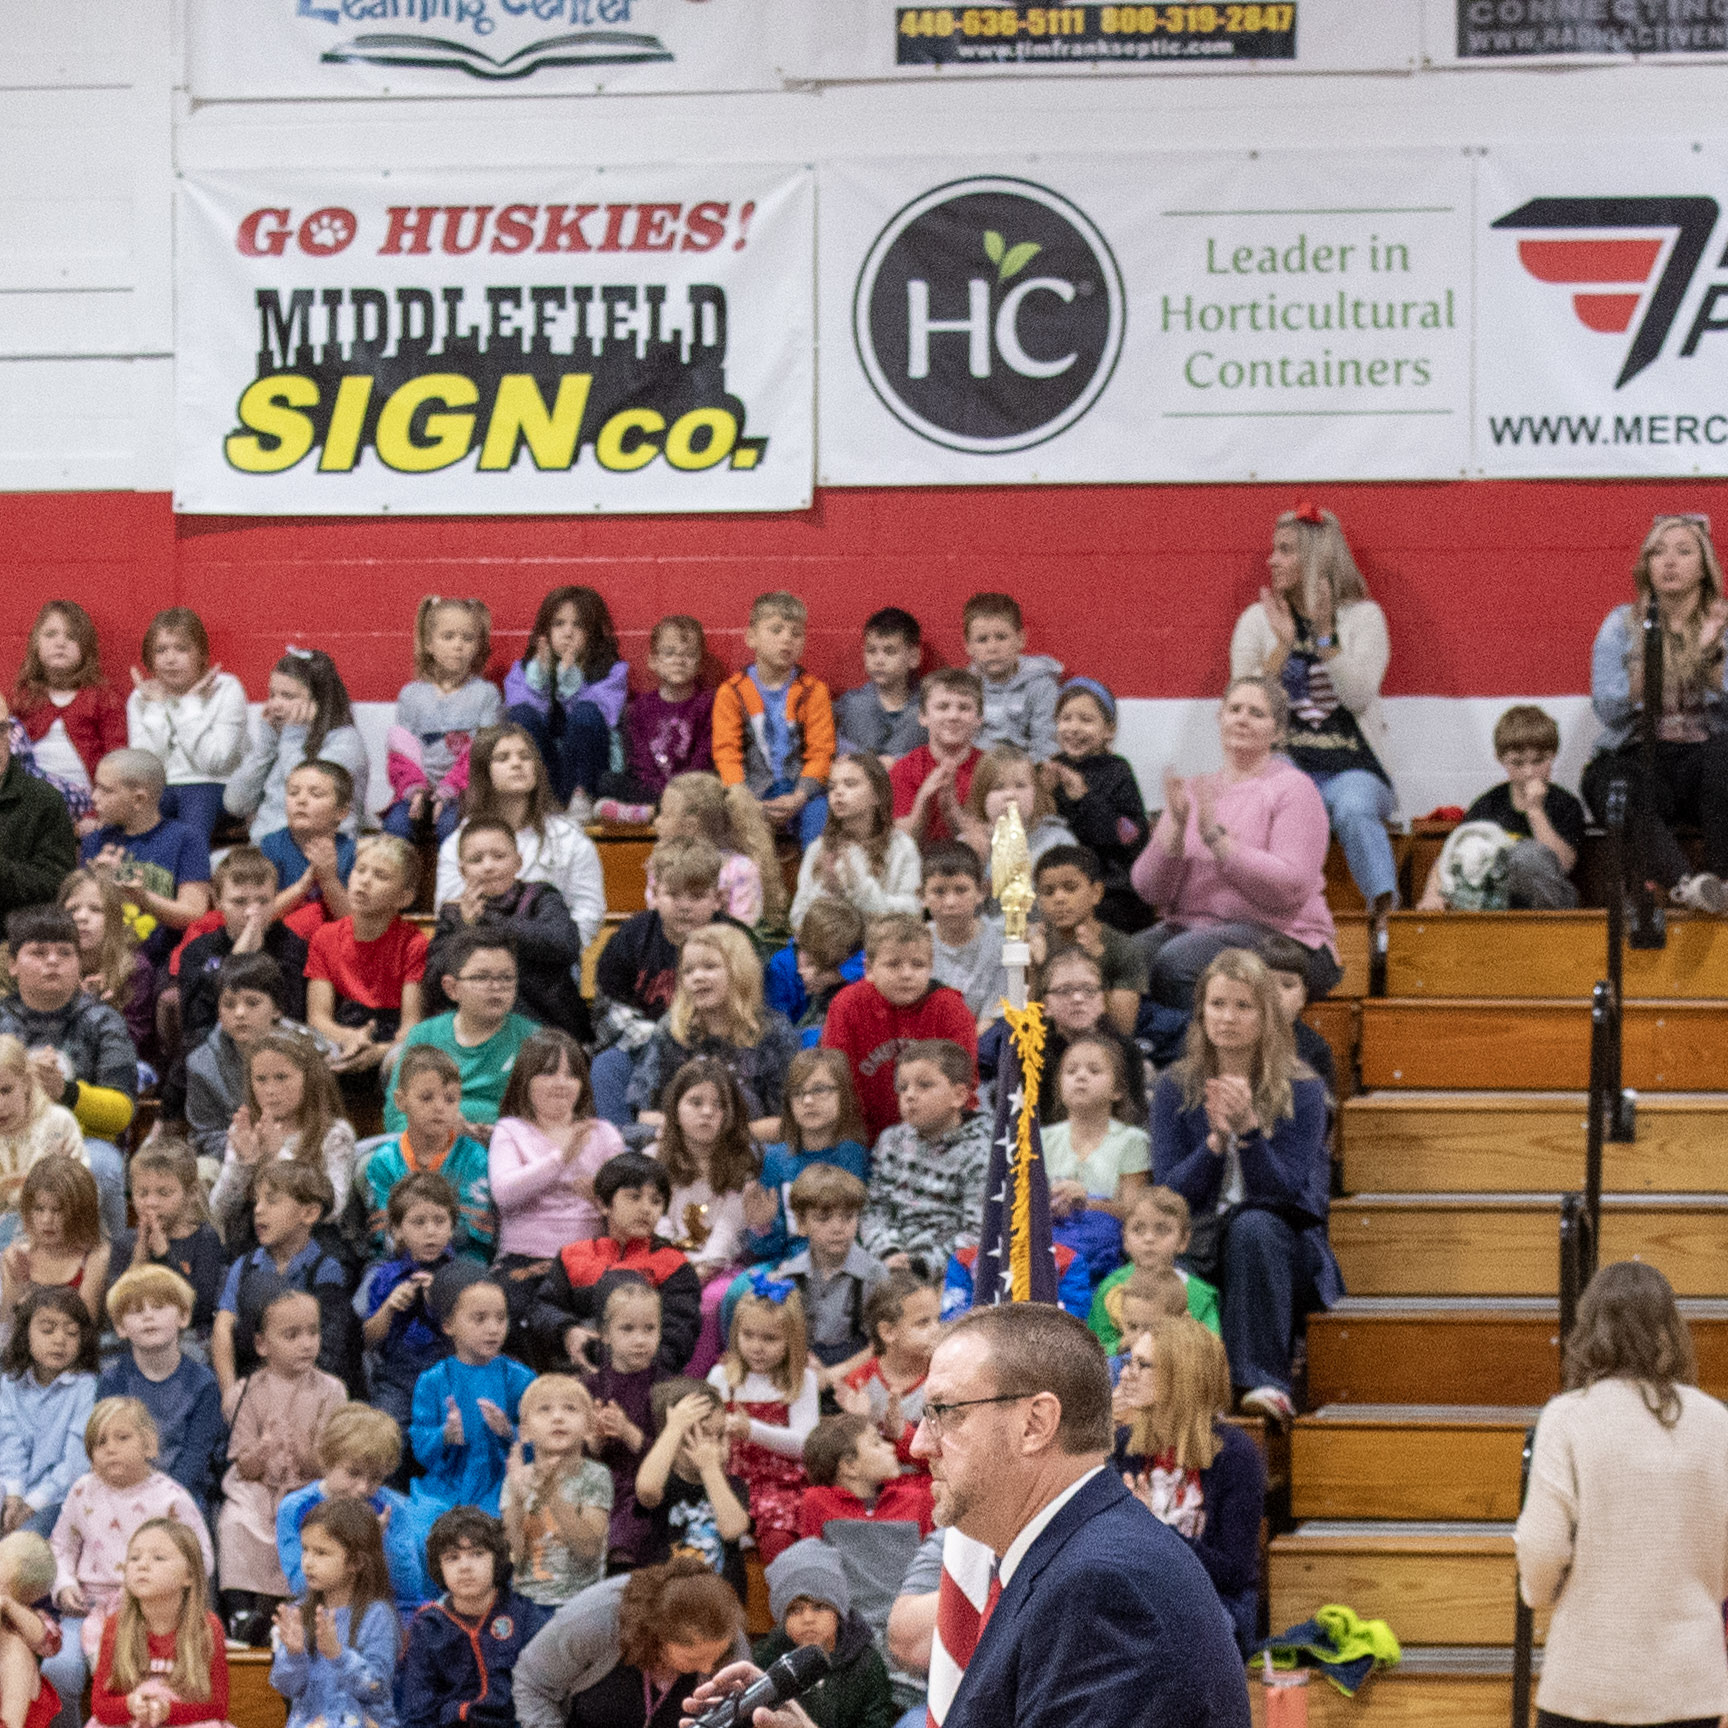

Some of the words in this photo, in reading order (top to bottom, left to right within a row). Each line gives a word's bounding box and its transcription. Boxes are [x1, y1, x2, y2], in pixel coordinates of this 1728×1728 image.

[899, 9, 1087, 38] 440-636-5111
[235, 206, 358, 258] GO
[378, 200, 757, 256] HUSKIES!
[1206, 235, 1356, 275] Leader
[1369, 234, 1412, 273] in
[254, 284, 729, 368] MIDDLEFIELD
[907, 277, 1079, 379] HC
[1159, 289, 1457, 334] Horticultural
[1184, 350, 1432, 390] Containers
[223, 373, 594, 475] SIGN
